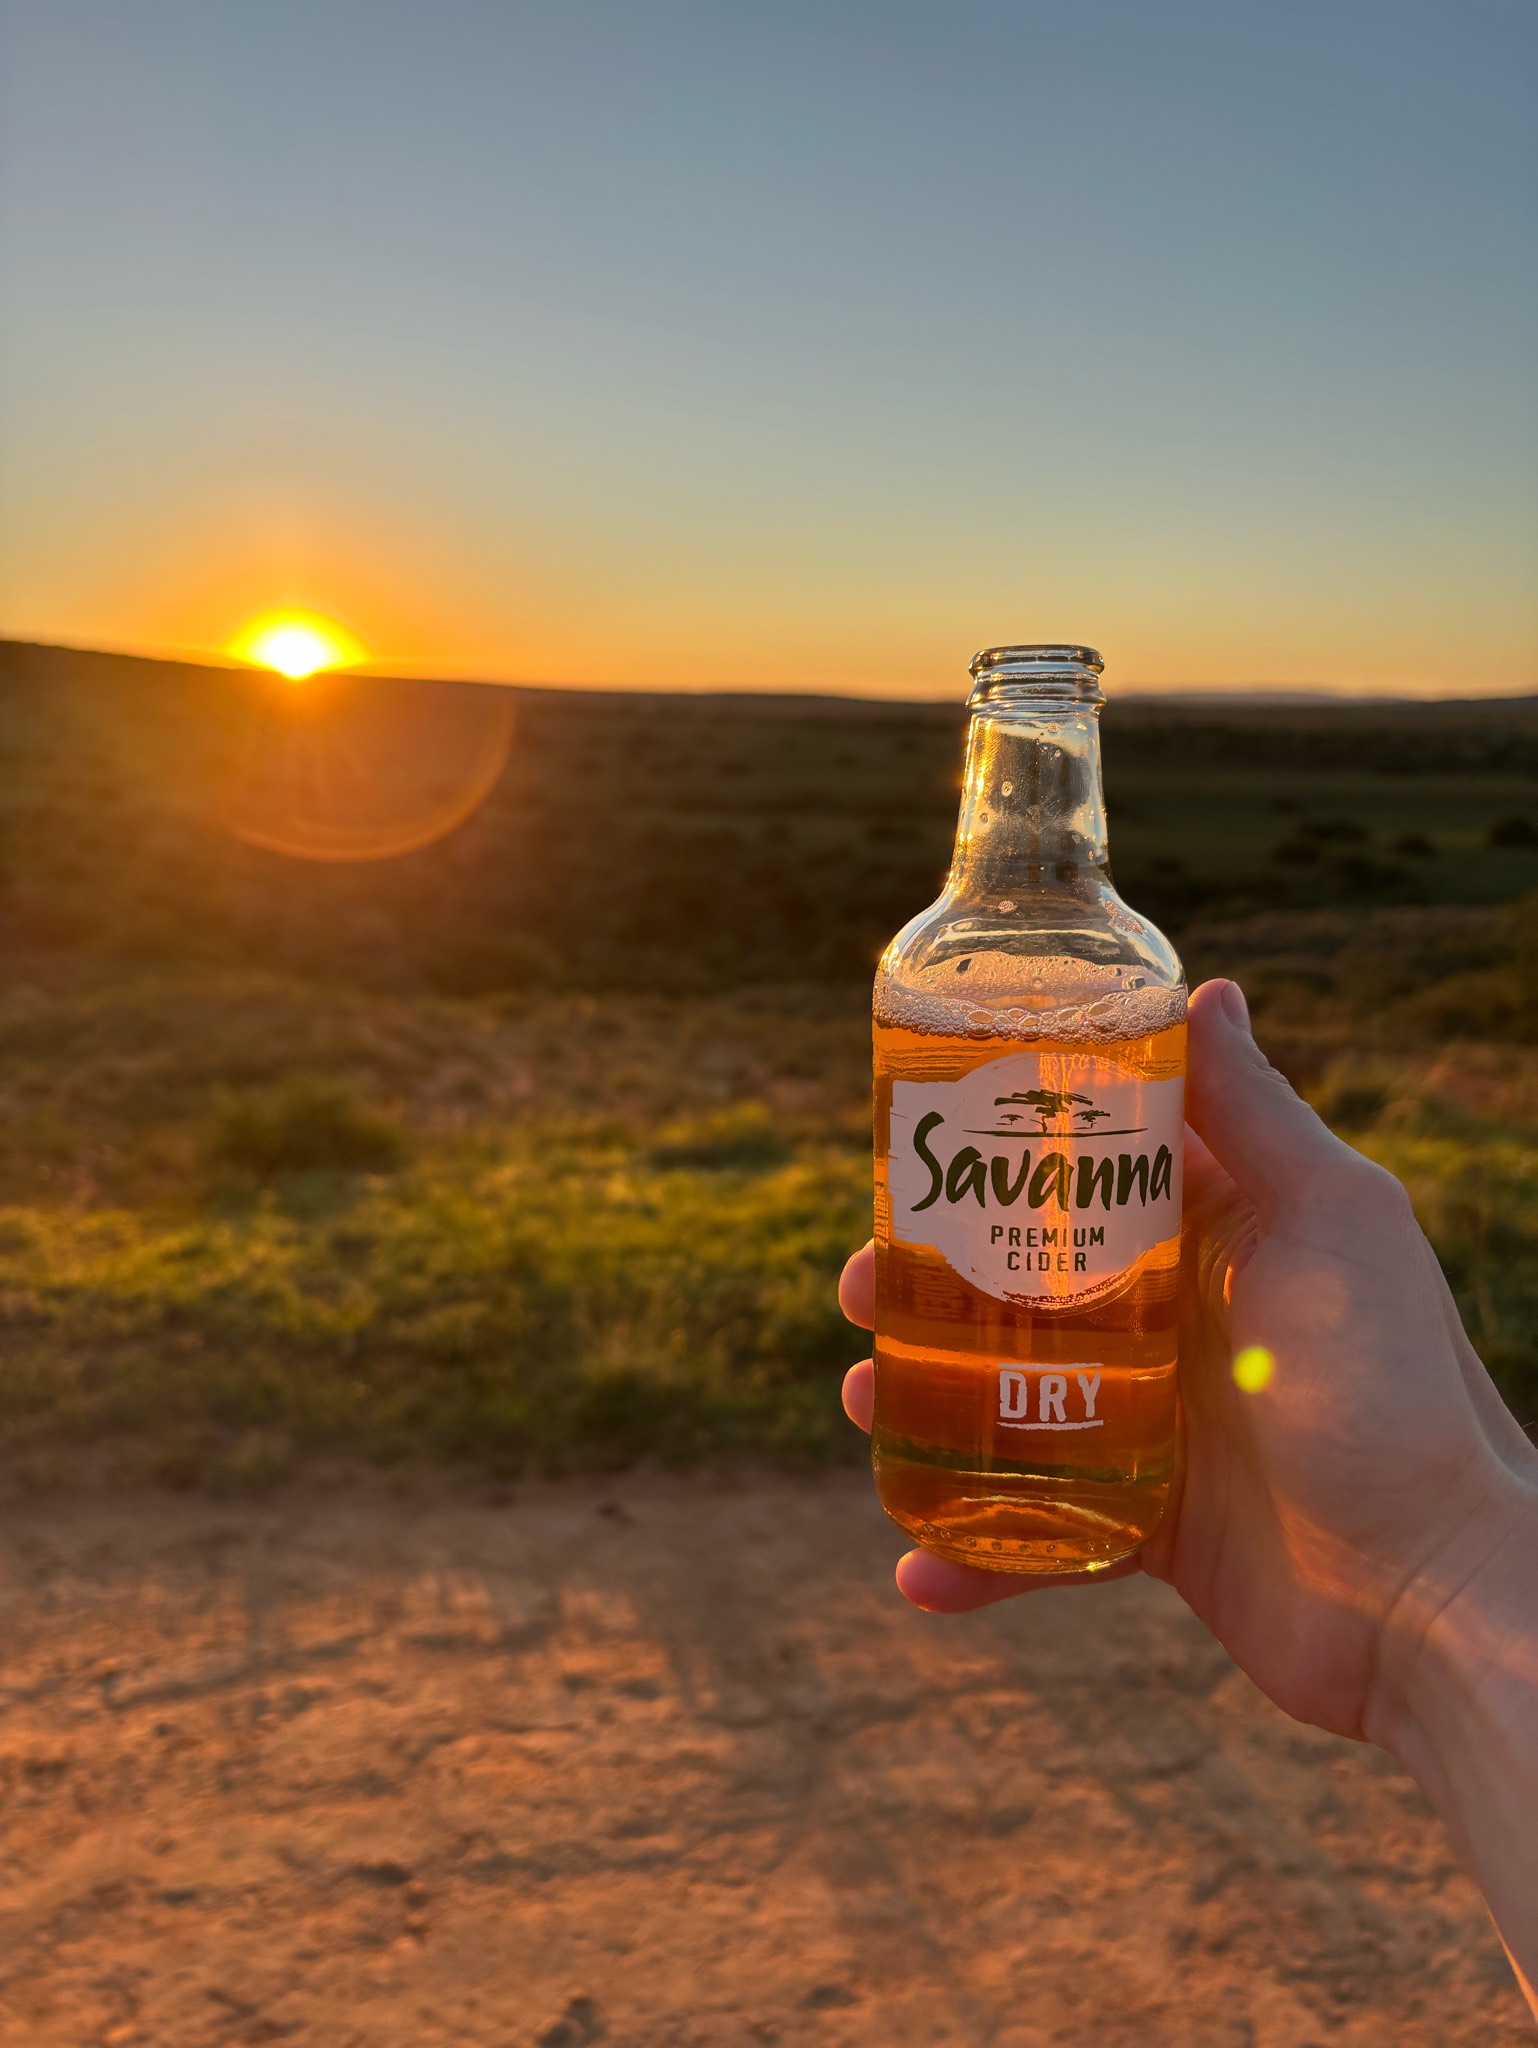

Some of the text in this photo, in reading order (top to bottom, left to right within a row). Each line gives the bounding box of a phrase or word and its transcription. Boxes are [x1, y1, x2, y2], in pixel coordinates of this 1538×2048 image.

[910, 1111, 1172, 1212] Savanna
[990, 1225, 1105, 1247] PREMIUM
[1007, 1251, 1087, 1272] CIDER
[999, 1369, 1101, 1422] DRY
